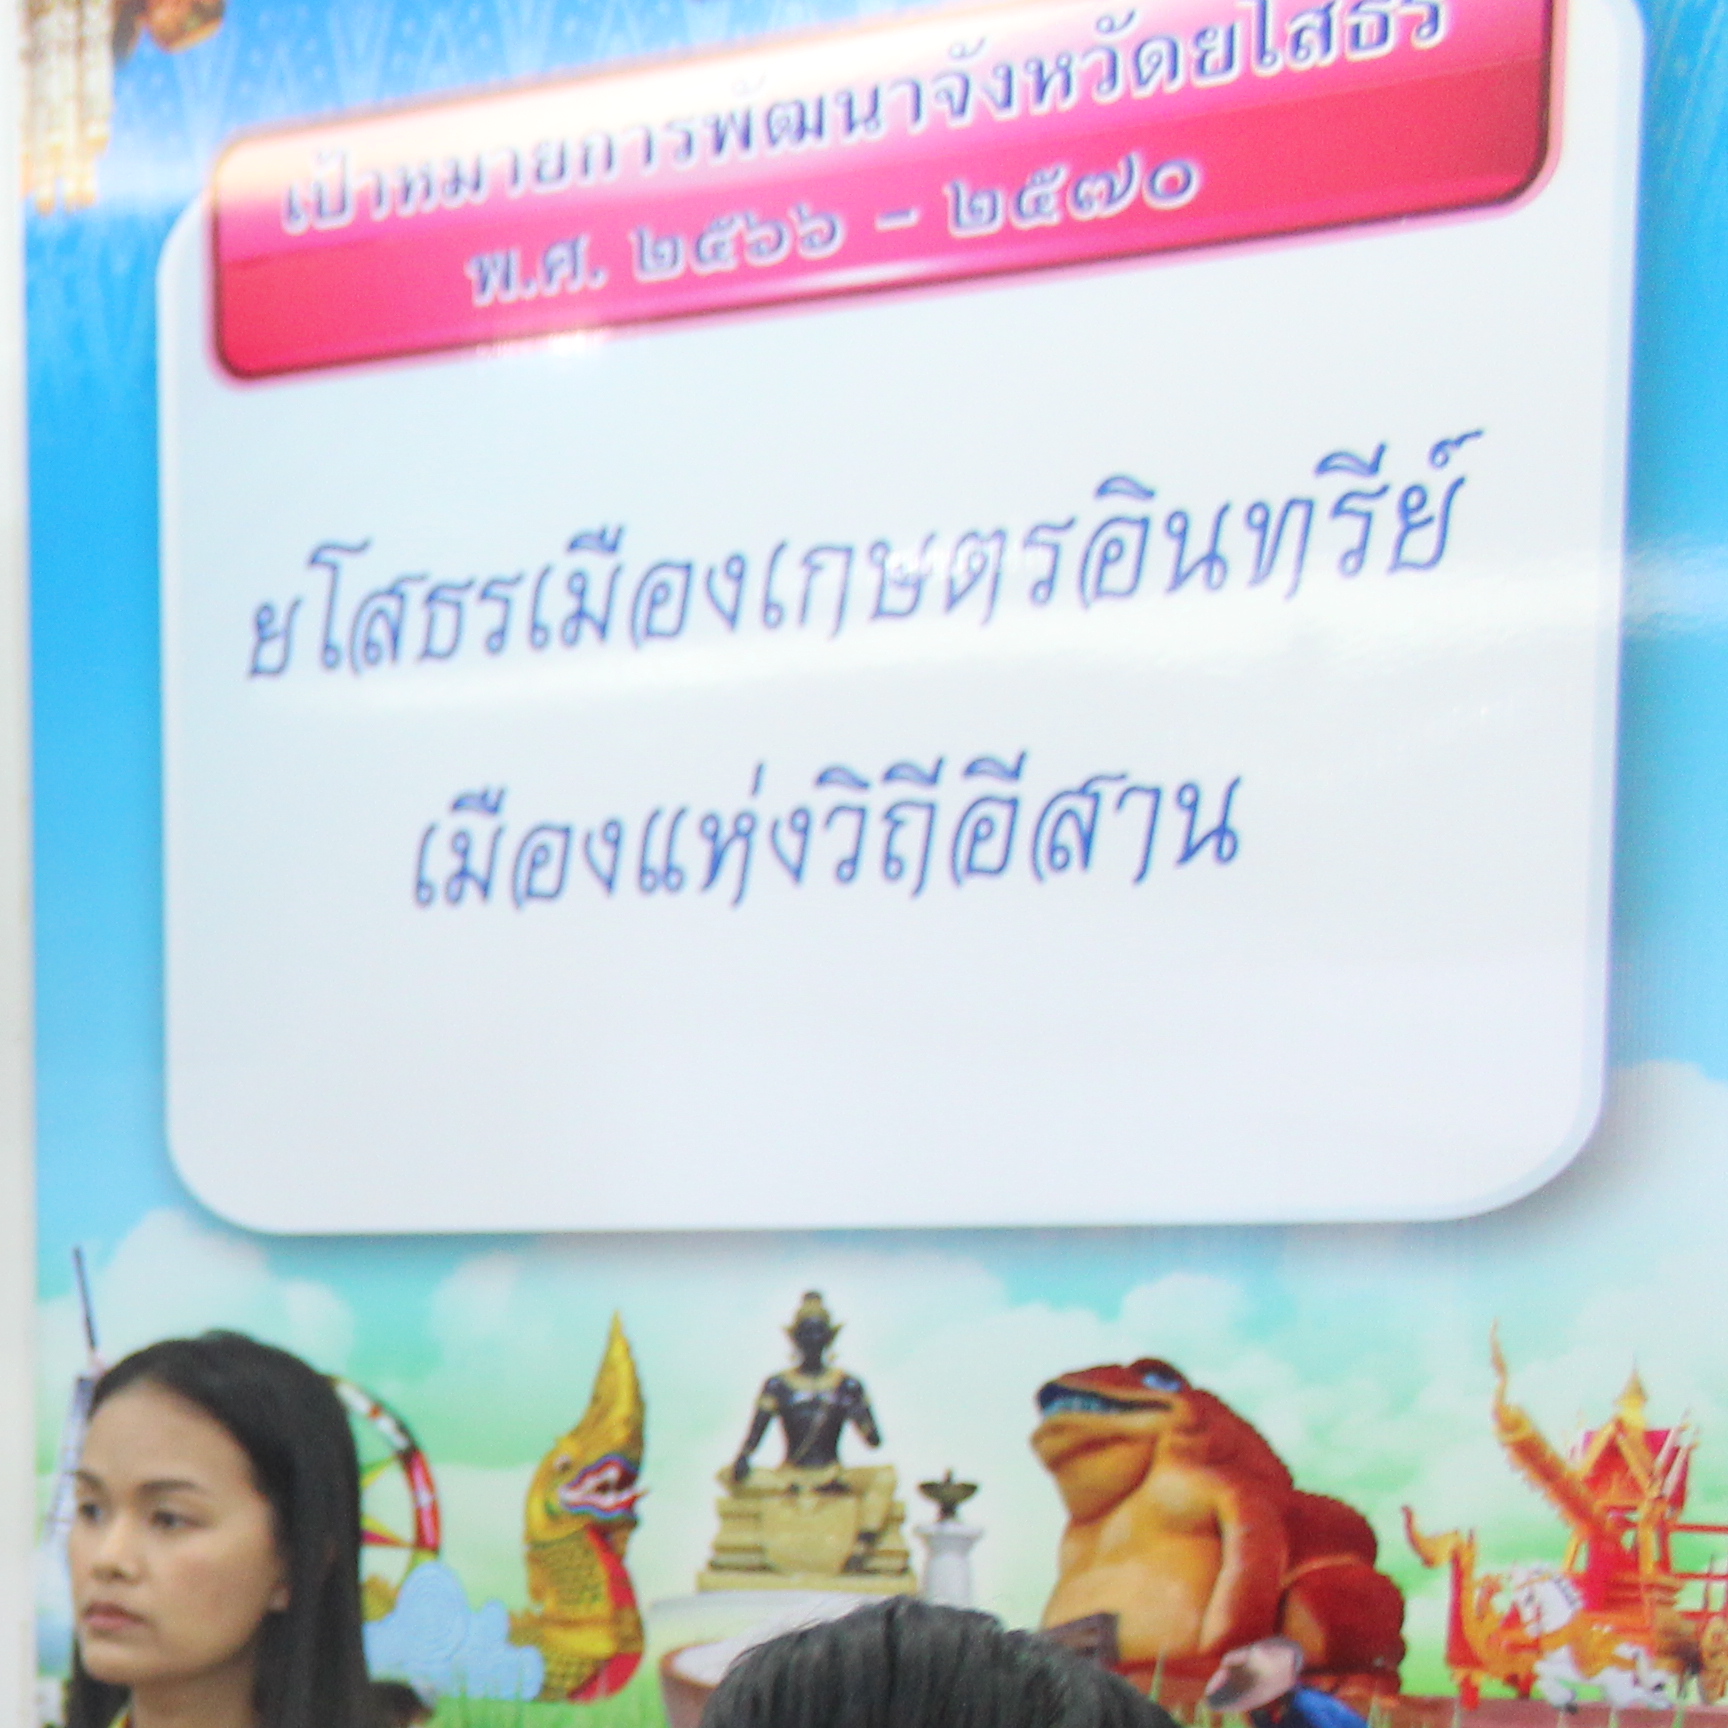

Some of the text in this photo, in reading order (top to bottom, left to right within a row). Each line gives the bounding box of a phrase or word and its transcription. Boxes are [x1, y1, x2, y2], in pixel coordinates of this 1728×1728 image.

[466, 232, 608, 308] พ.ศ.
[632, 200, 844, 284] ๒๕๖๖
[944, 152, 1202, 238] ๒๕๗๐
[247, 427, 1485, 679] ยโสธรเมืองเกษตรอินทรีย์
[412, 750, 1242, 909] เมืองแห่งวิถีอีสาน
